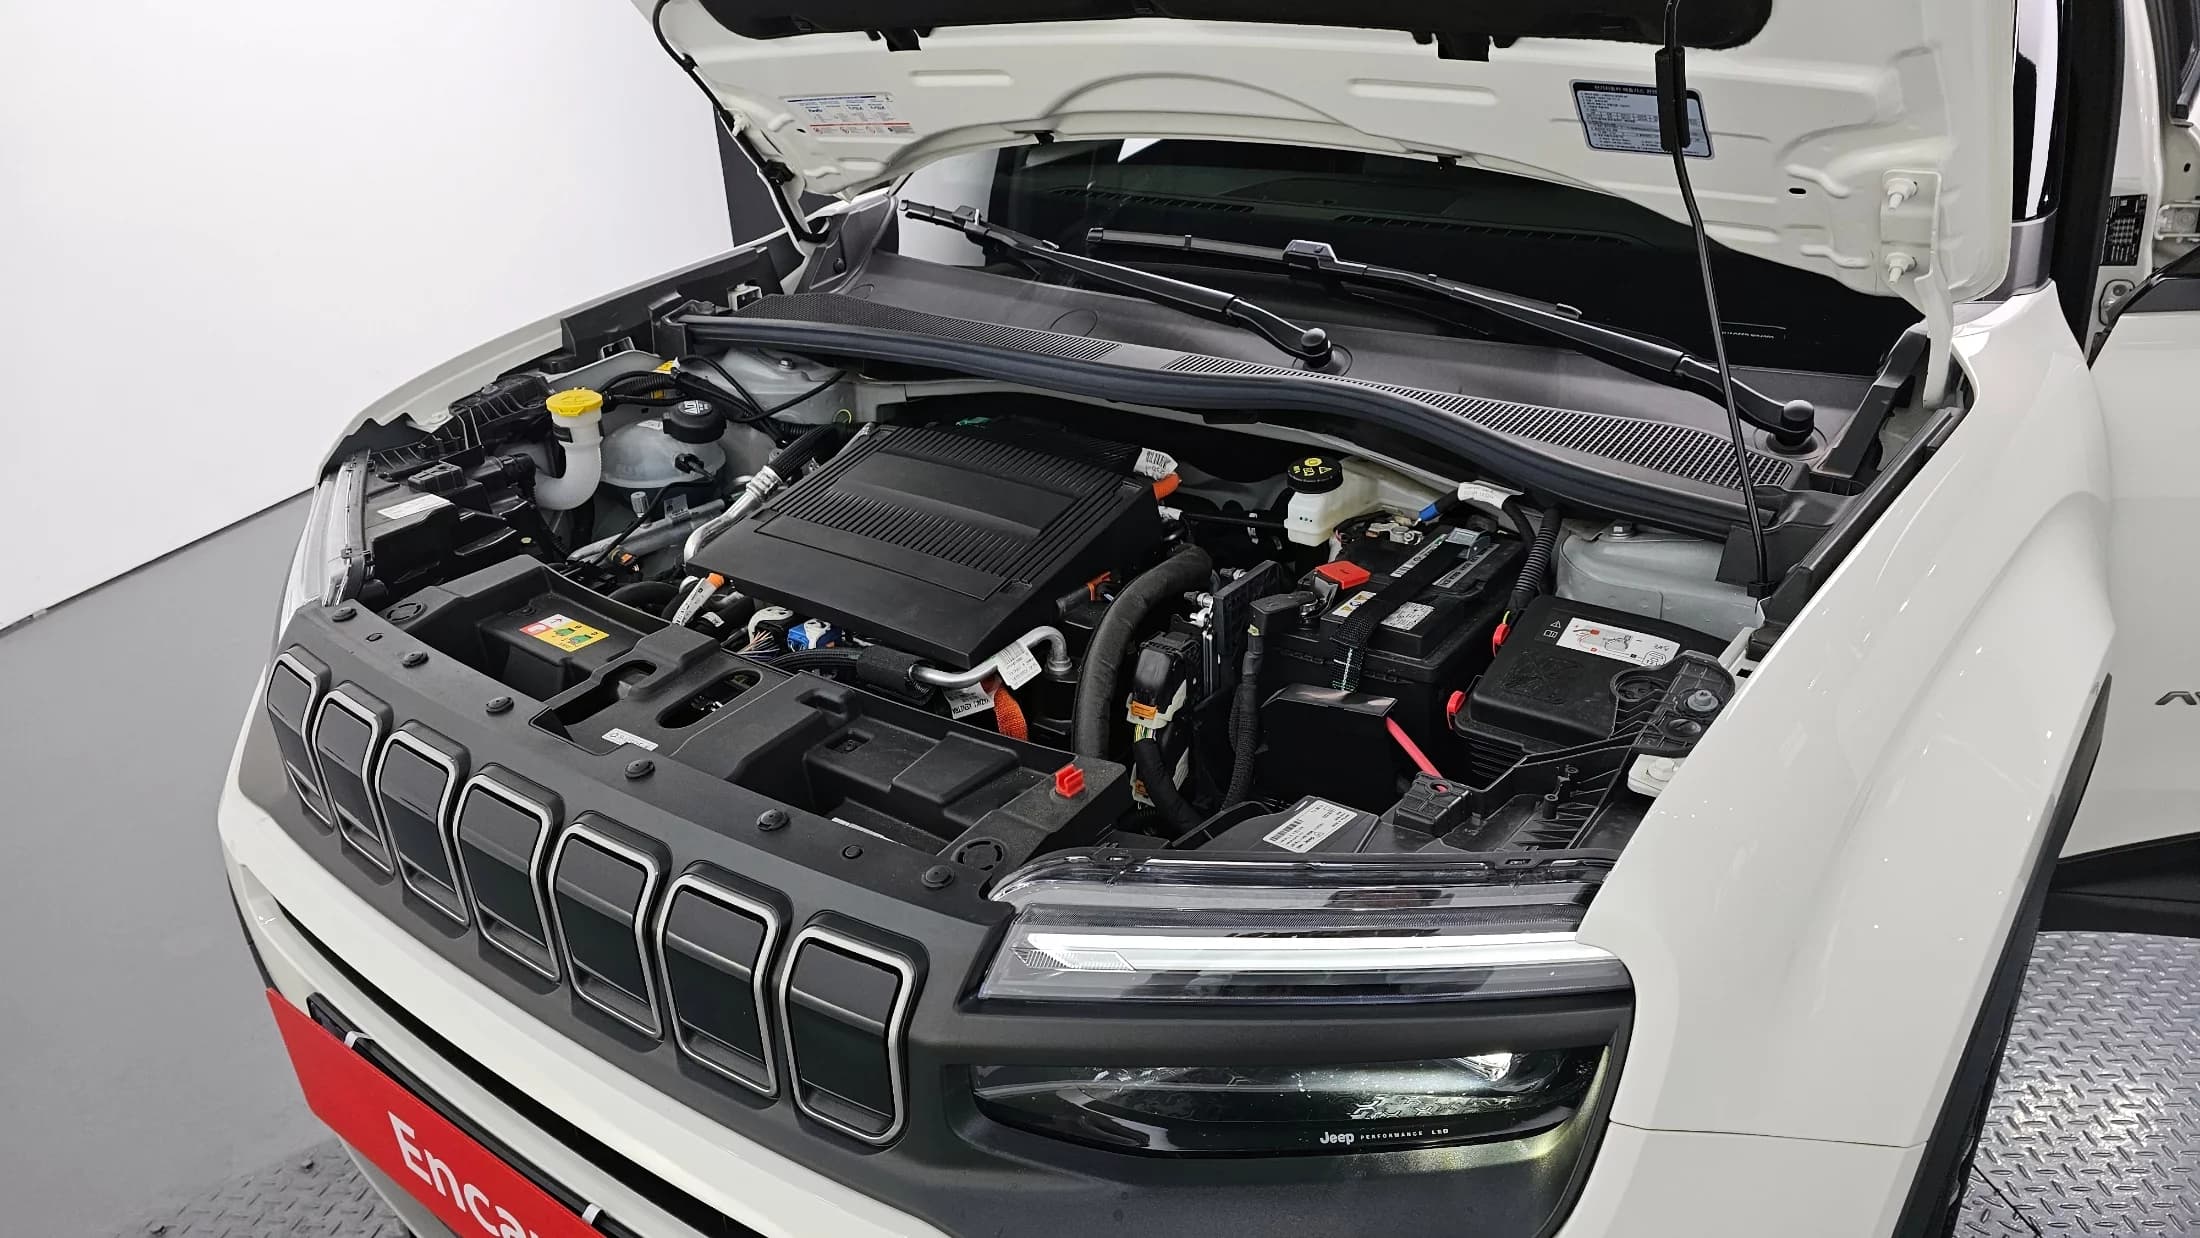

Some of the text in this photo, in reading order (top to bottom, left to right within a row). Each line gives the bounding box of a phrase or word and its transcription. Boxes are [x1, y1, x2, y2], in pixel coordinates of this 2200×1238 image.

[1319, 1131, 1355, 1145] Jeep
[1360, 1130, 1424, 1140] PERFORMANCE
[387, 1110, 540, 1238] Enca
